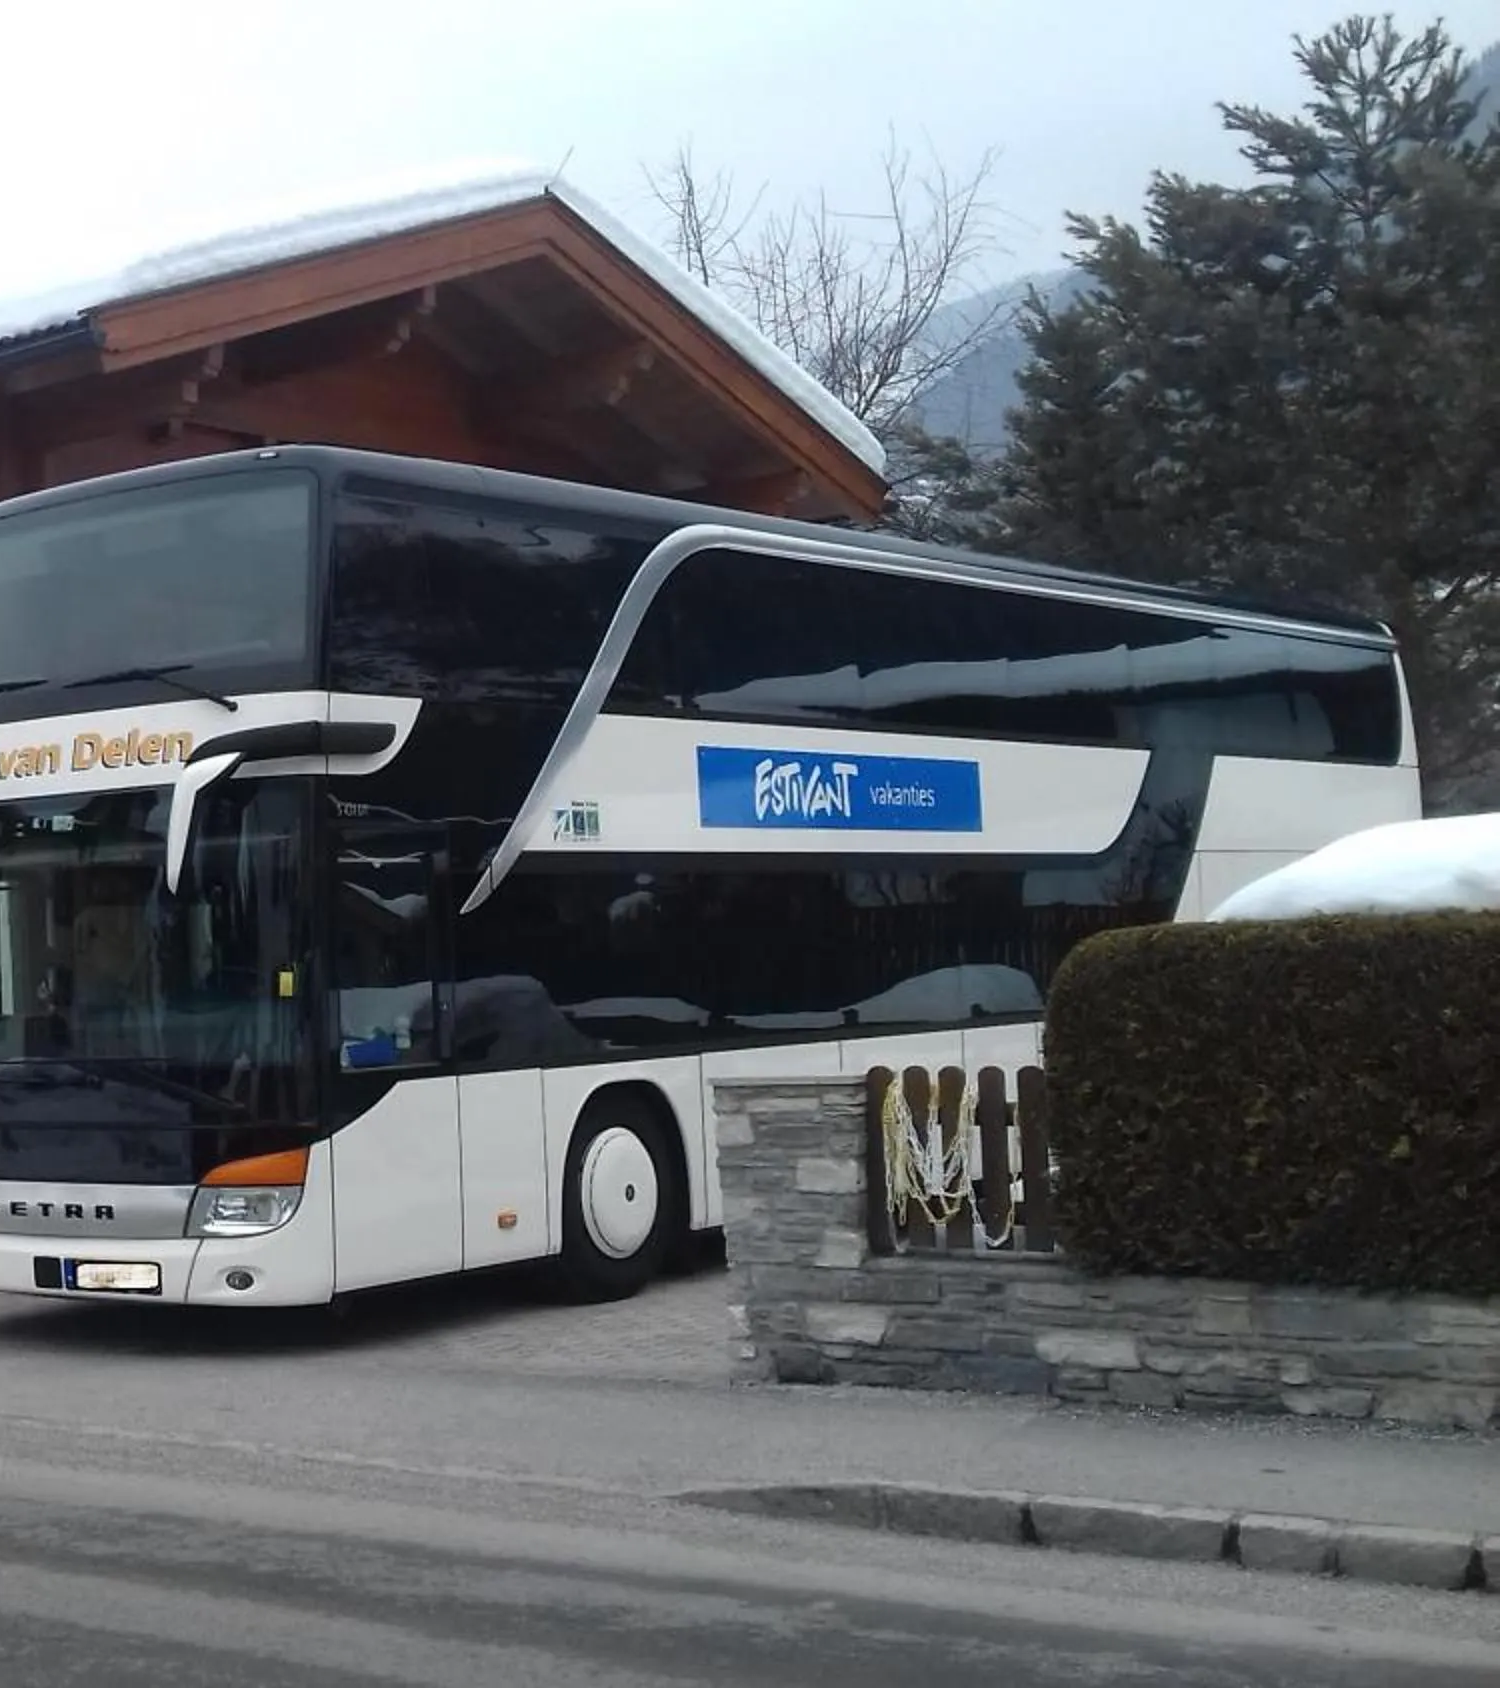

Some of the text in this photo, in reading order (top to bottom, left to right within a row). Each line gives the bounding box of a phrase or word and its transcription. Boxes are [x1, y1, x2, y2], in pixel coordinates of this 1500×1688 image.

[72, 728, 195, 772] Delen
[755, 758, 936, 821] ESTIVANT vakanties
